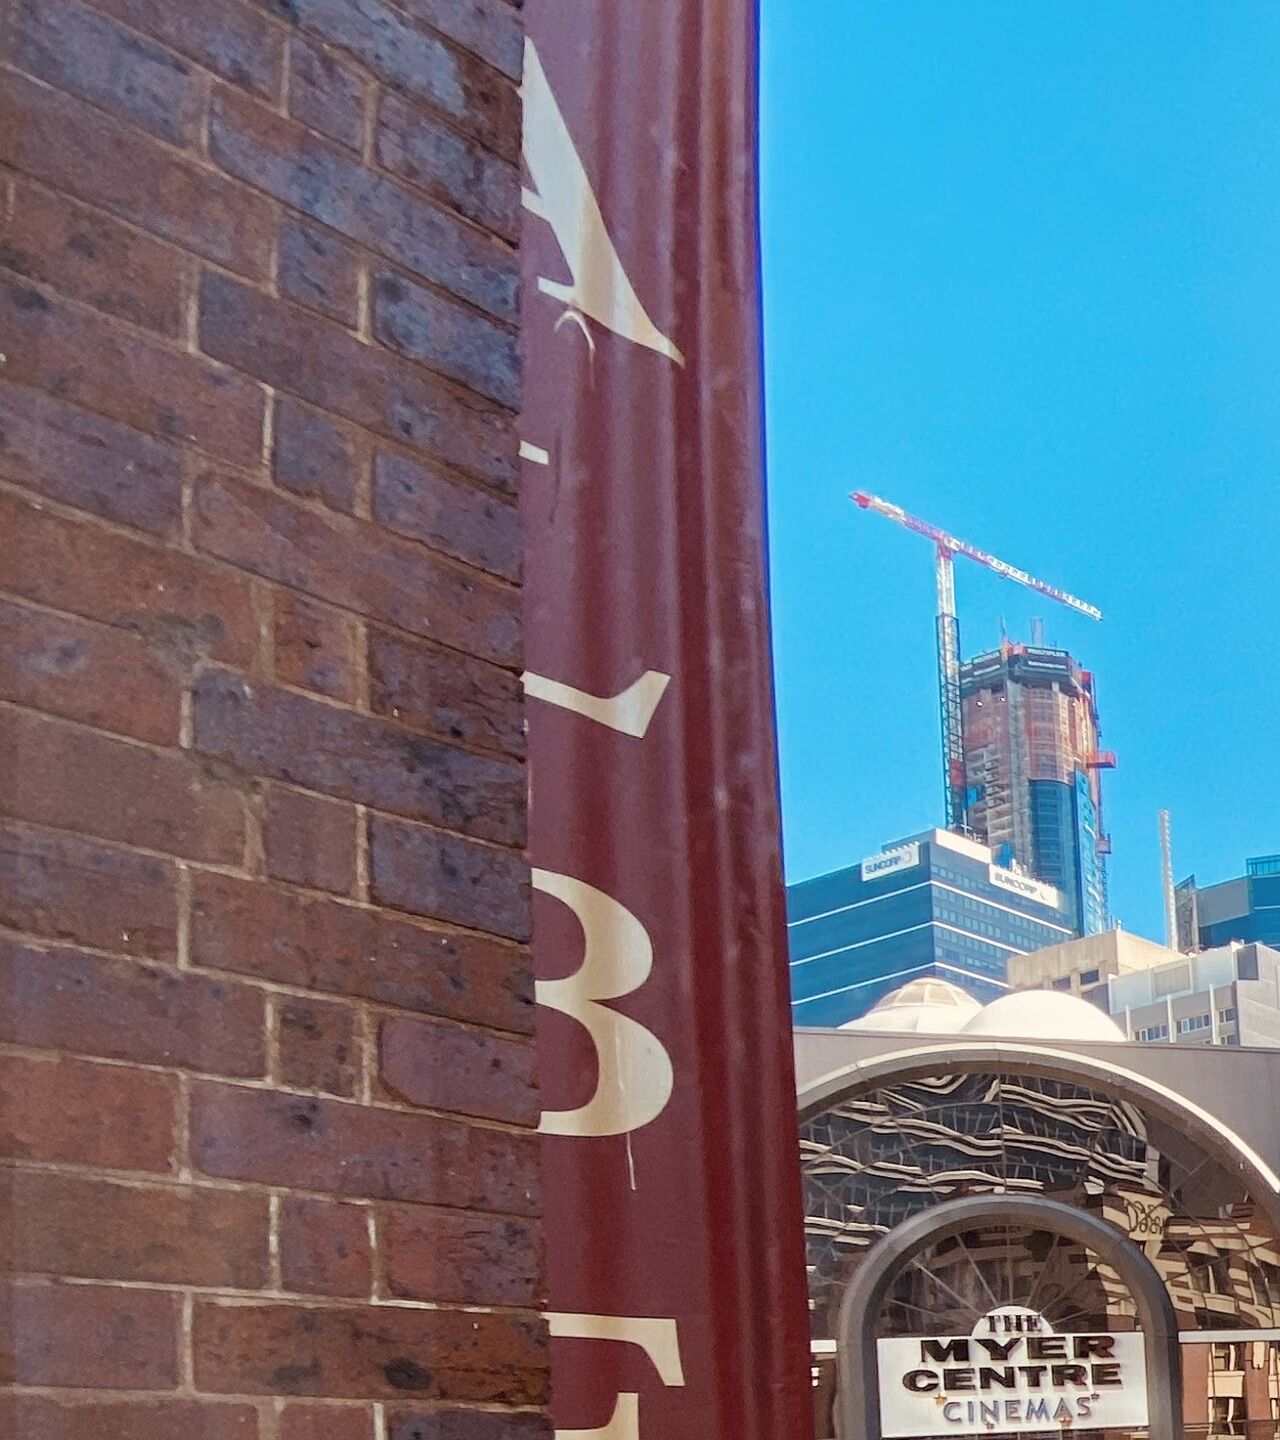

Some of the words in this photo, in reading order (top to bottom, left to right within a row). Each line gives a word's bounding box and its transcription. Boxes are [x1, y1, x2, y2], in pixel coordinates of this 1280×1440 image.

[865, 854, 902, 875] SUNCORP
[994, 872, 1038, 894] SUNCORP
[984, 1313, 1042, 1333] THE
[920, 1335, 1116, 1363] MYER
[902, 1362, 1123, 1392] CENTRE
[943, 1397, 1092, 1424] CINEMAS
